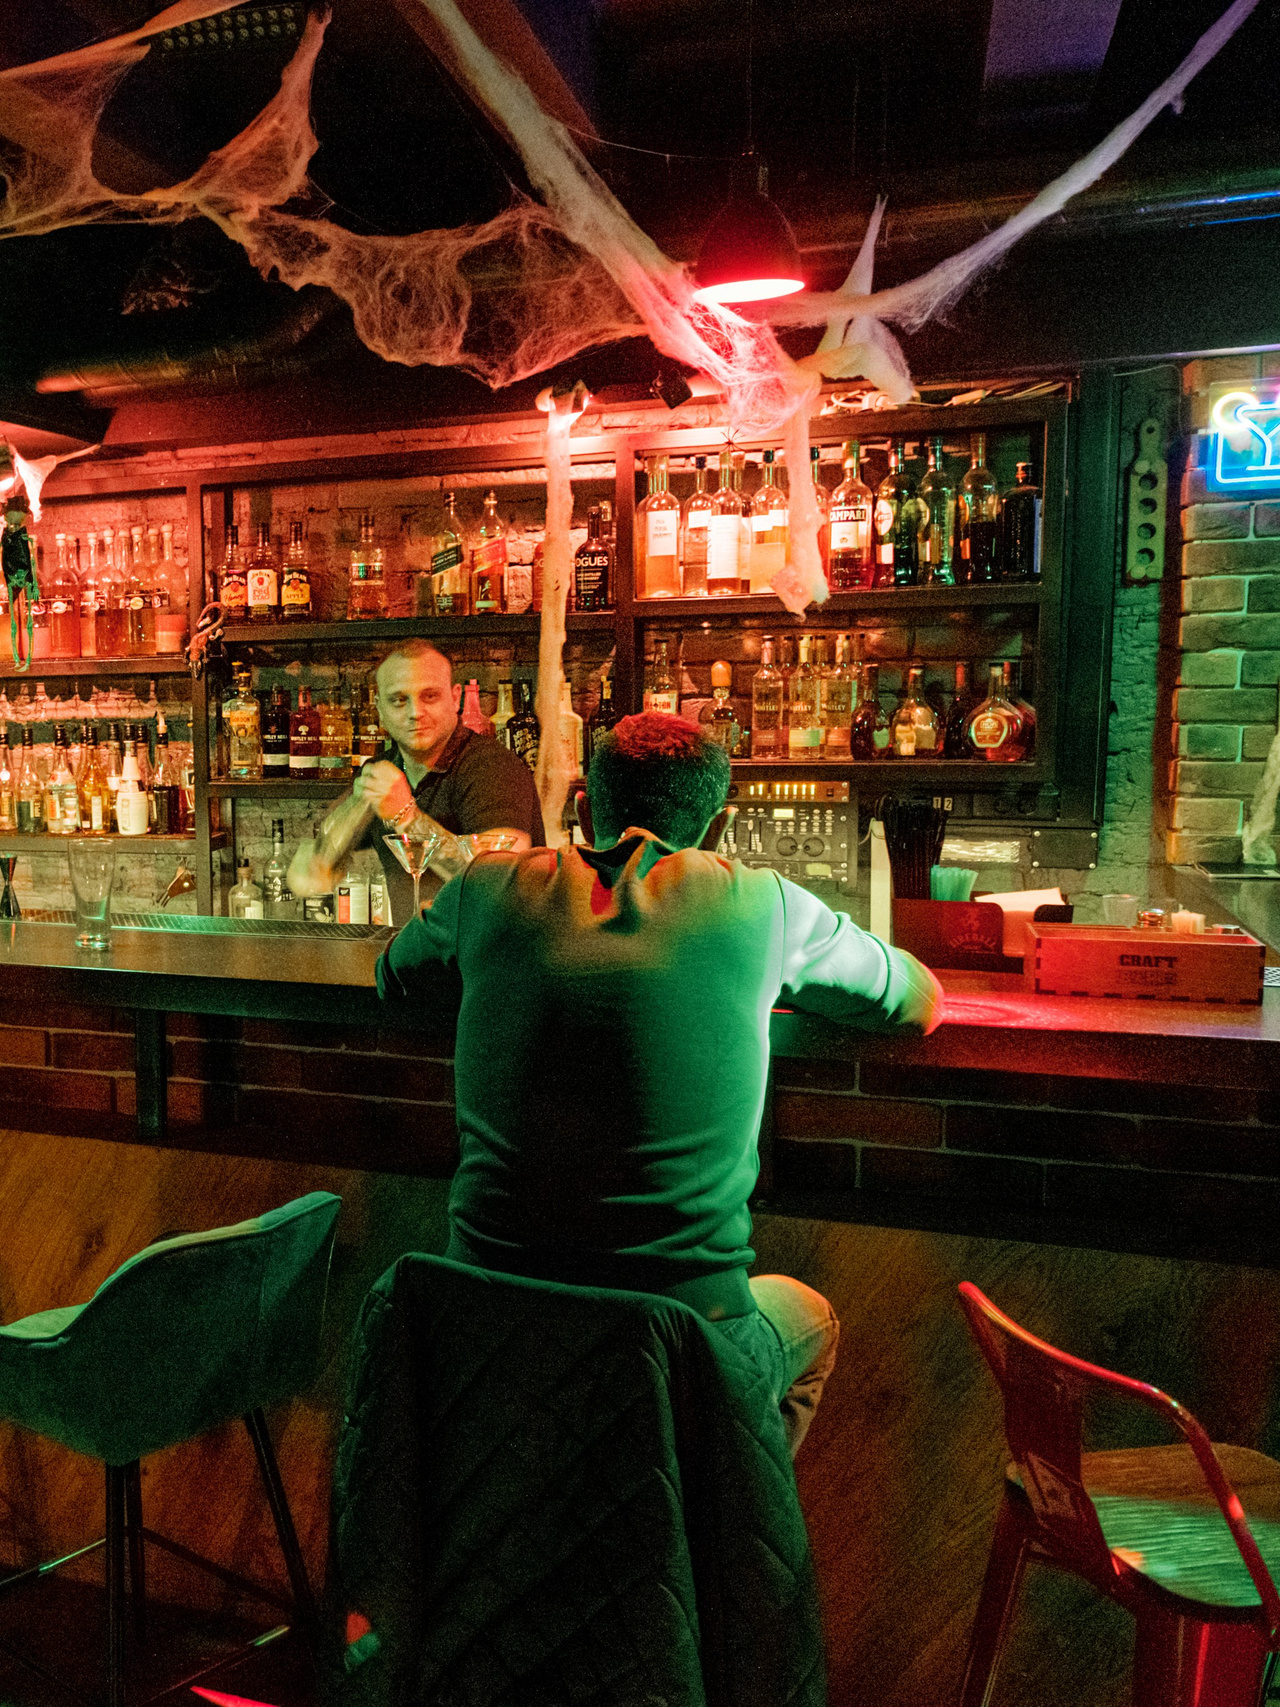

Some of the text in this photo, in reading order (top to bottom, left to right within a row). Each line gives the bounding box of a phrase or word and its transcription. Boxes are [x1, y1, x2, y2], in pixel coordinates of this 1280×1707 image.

[576, 556, 609, 567] OGUES
[945, 799, 952, 809] 2
[1119, 954, 1178, 968] CRAFT
